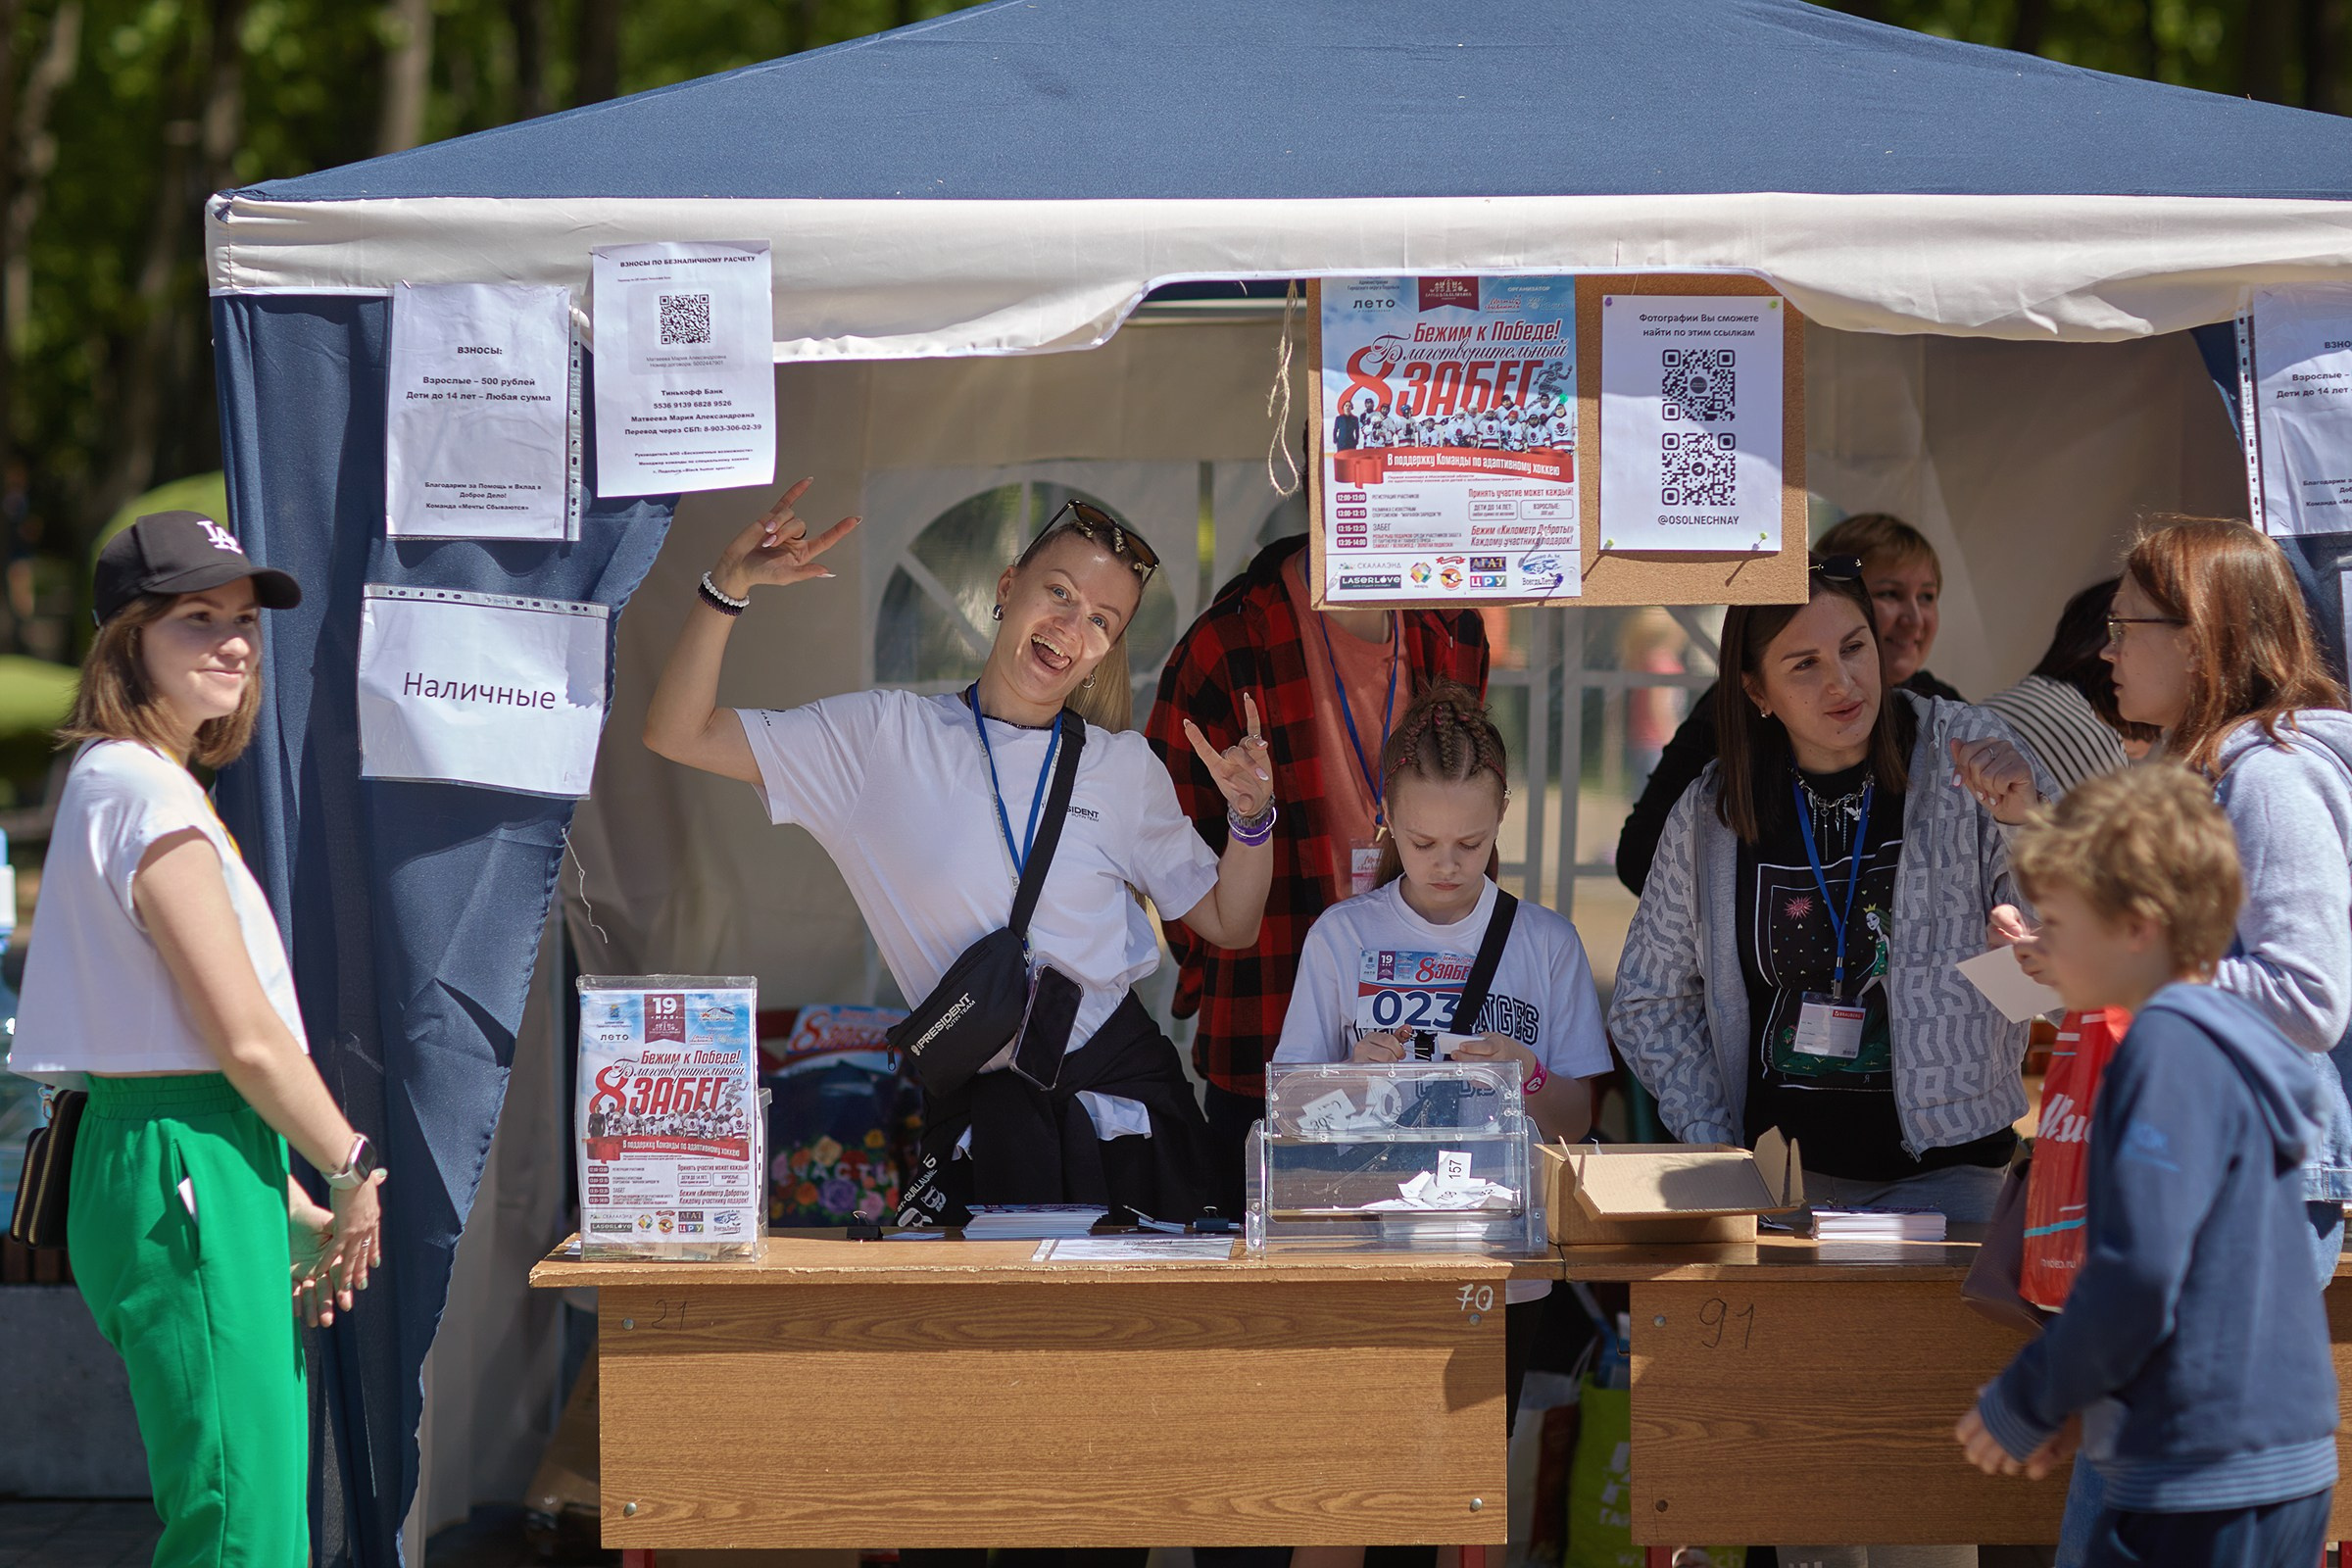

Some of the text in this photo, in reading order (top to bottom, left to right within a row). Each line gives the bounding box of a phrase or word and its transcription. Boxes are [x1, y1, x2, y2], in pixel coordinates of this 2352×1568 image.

[1353, 299, 1396, 309] лето
[1639, 314, 1698, 324] Фотографии
[1701, 314, 1715, 322] Вы
[1413, 319, 1561, 343] Бежим к Победе!
[1642, 328, 1671, 337] найти
[1366, 332, 1569, 370] Благотворительный
[423, 376, 471, 386] Взрослые
[501, 378, 535, 387] рублей
[1337, 345, 1544, 416] 8 ЗАБЕГ
[2292, 372, 2342, 382] Взрослые
[406, 392, 429, 401] Дети
[431, 392, 444, 401] до
[486, 392, 518, 401] Любая
[520, 394, 552, 403] сумма
[2277, 390, 2300, 400] Дети
[696, 412, 755, 420] Александровна
[1388, 453, 1560, 476] В поддержку Команды по адаптивному хоккею
[2303, 479, 2346, 488] Благодарим
[1469, 489, 1495, 499] Принять
[1496, 490, 1522, 499] участие
[1545, 487, 1574, 497] каждый!
[1658, 515, 1740, 526] @OSOLNECHNAY
[197, 520, 243, 555] LA
[1472, 525, 1495, 536] Бежим
[1497, 525, 1536, 535] «Километр
[1471, 535, 1573, 547] Каждому участнику подарок!
[1473, 558, 1504, 568] АГАТ
[1471, 576, 1505, 587] ЦРУ
[404, 672, 556, 710] Наличные
[1415, 956, 1436, 983] 8
[652, 998, 677, 1014] 19
[1372, 990, 1462, 1029] 023
[918, 992, 970, 1051] PRESIDENT
[945, 1000, 976, 1031] PUTIN TEAM
[641, 1051, 742, 1065] Бежим к Победе!
[610, 1058, 746, 1085] Благотворительный
[589, 1066, 730, 1115] 8 ЗАБЕГ
[1448, 1160, 1462, 1180] 157
[1456, 1284, 1494, 1312] 70
[1699, 1298, 1754, 1349] 91
